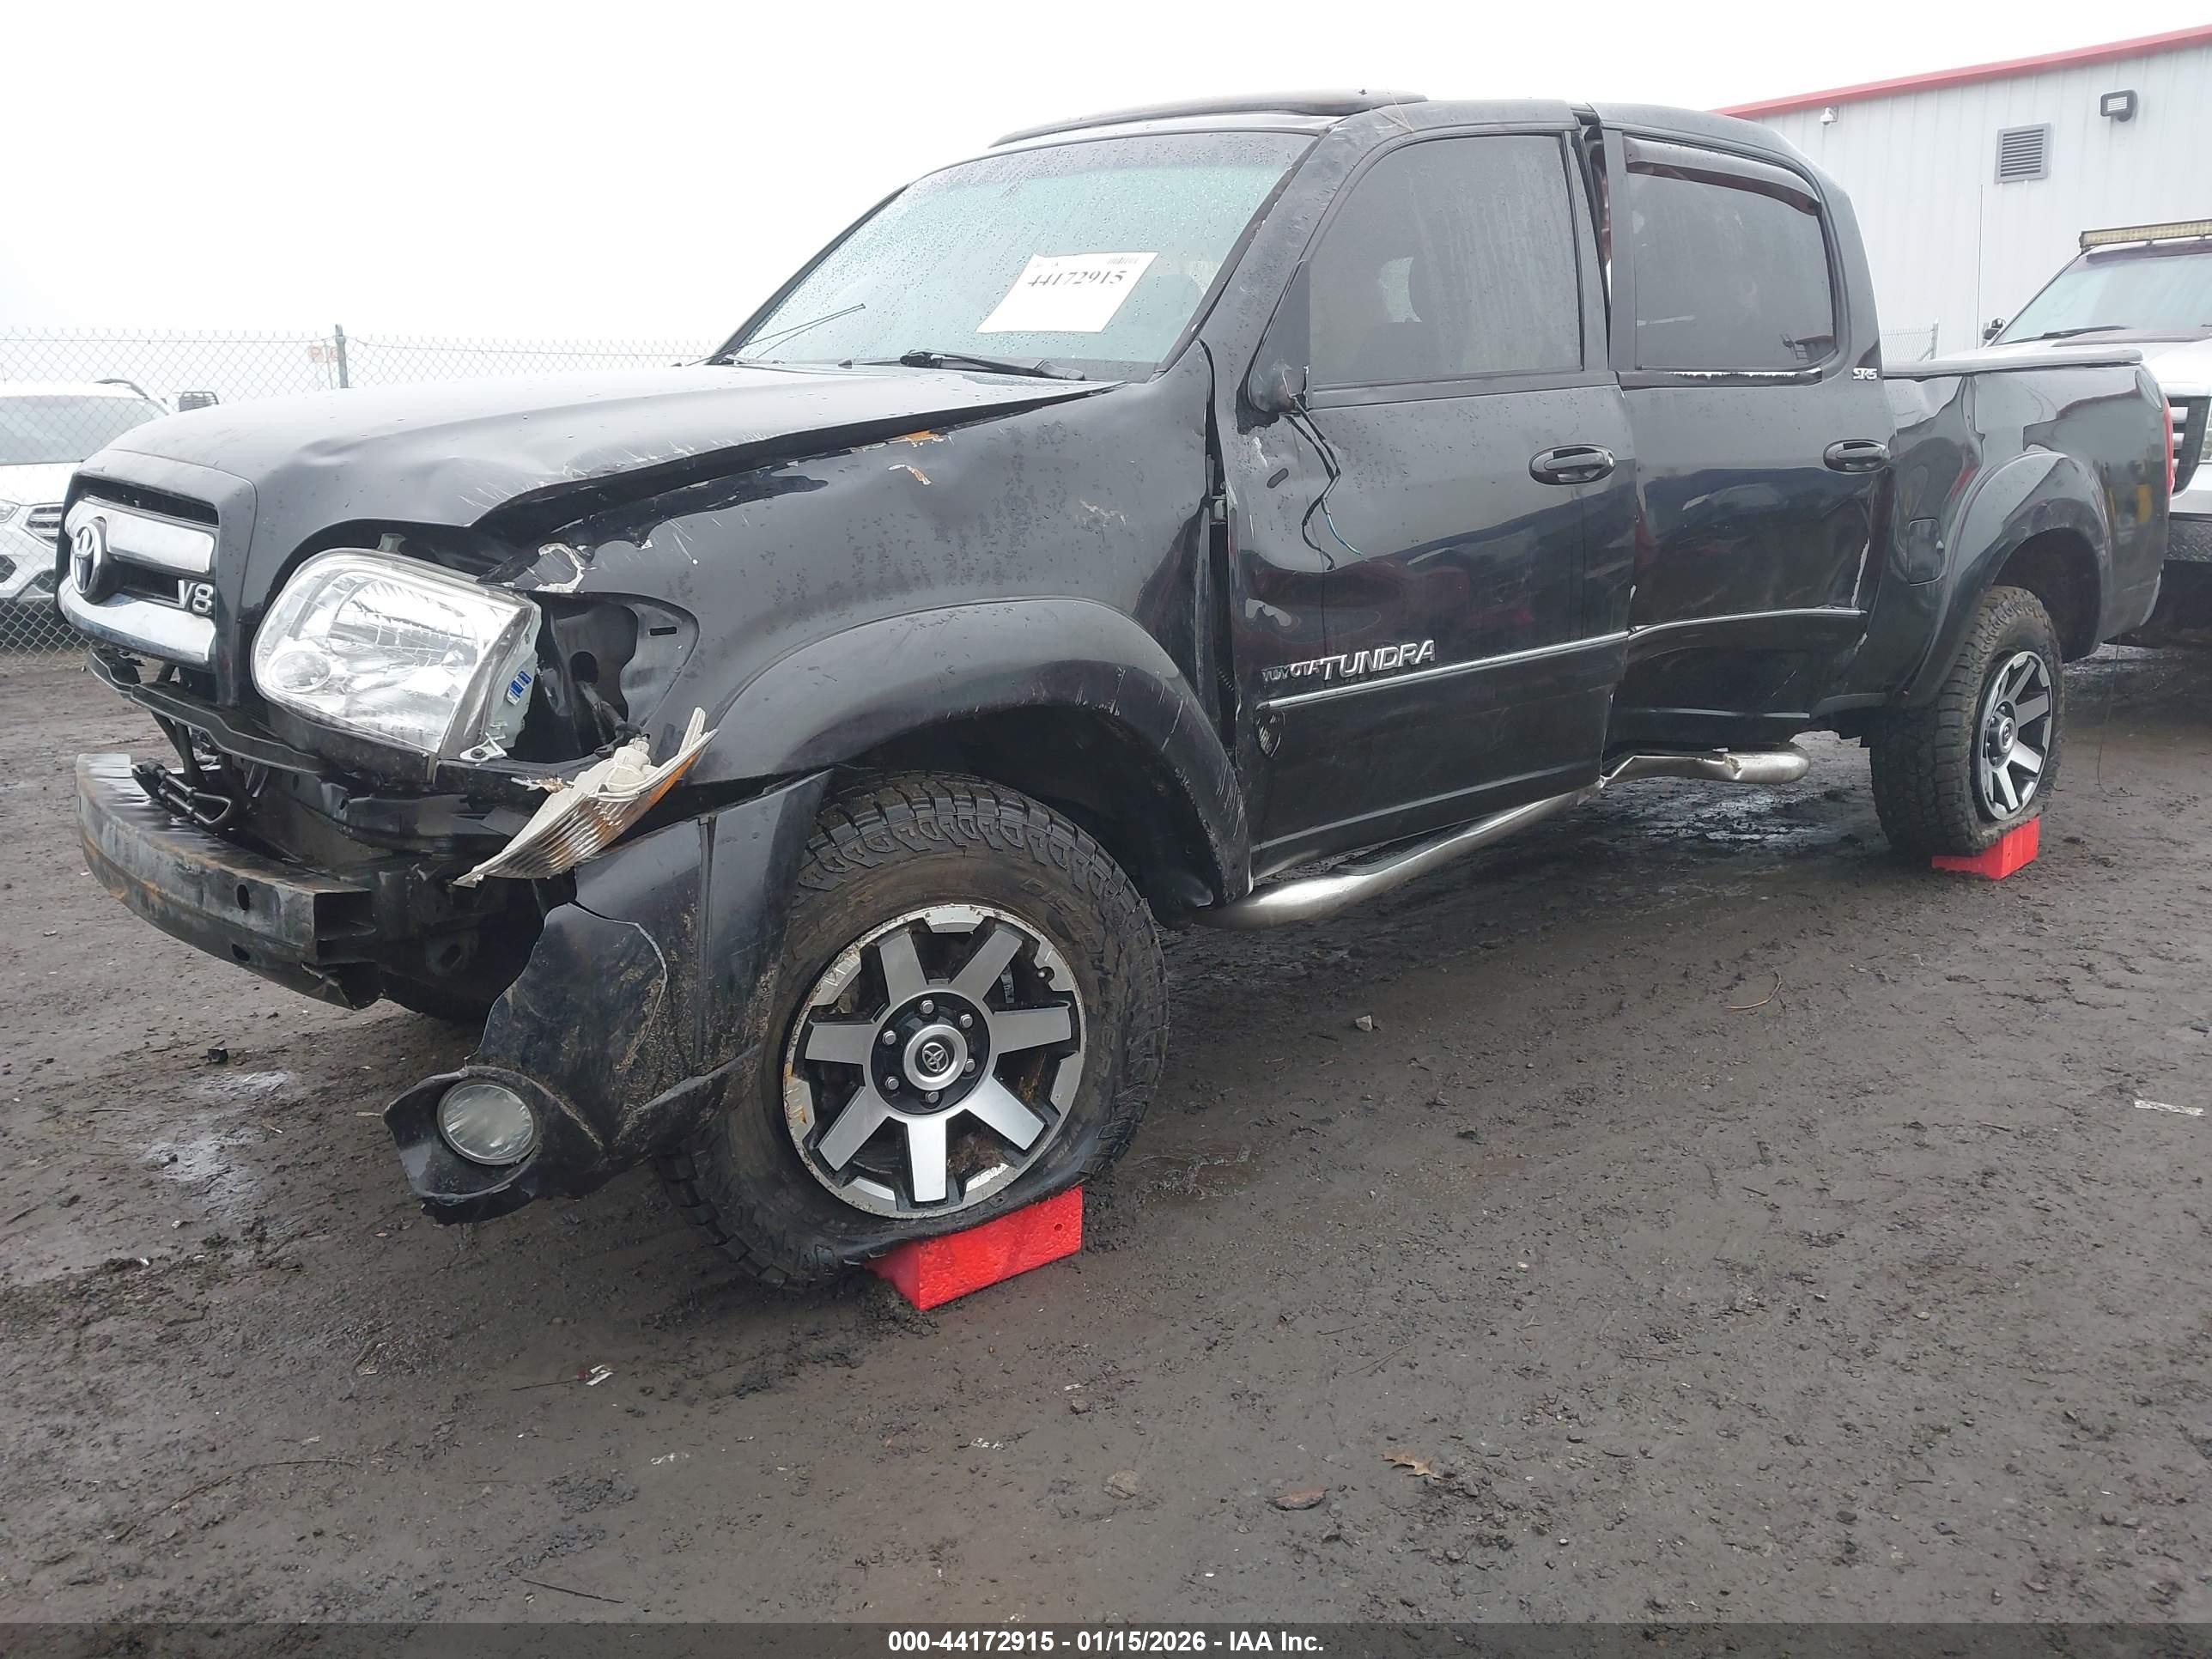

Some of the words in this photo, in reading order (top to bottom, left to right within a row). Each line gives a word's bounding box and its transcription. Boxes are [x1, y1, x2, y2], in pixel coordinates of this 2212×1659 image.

[1028, 270, 1127, 287] 44172915
[1852, 367, 1878, 380] SR5
[178, 580, 214, 613] V8
[1260, 659, 1321, 683] TOYOTA
[1319, 639, 1437, 681] TUNDRA
